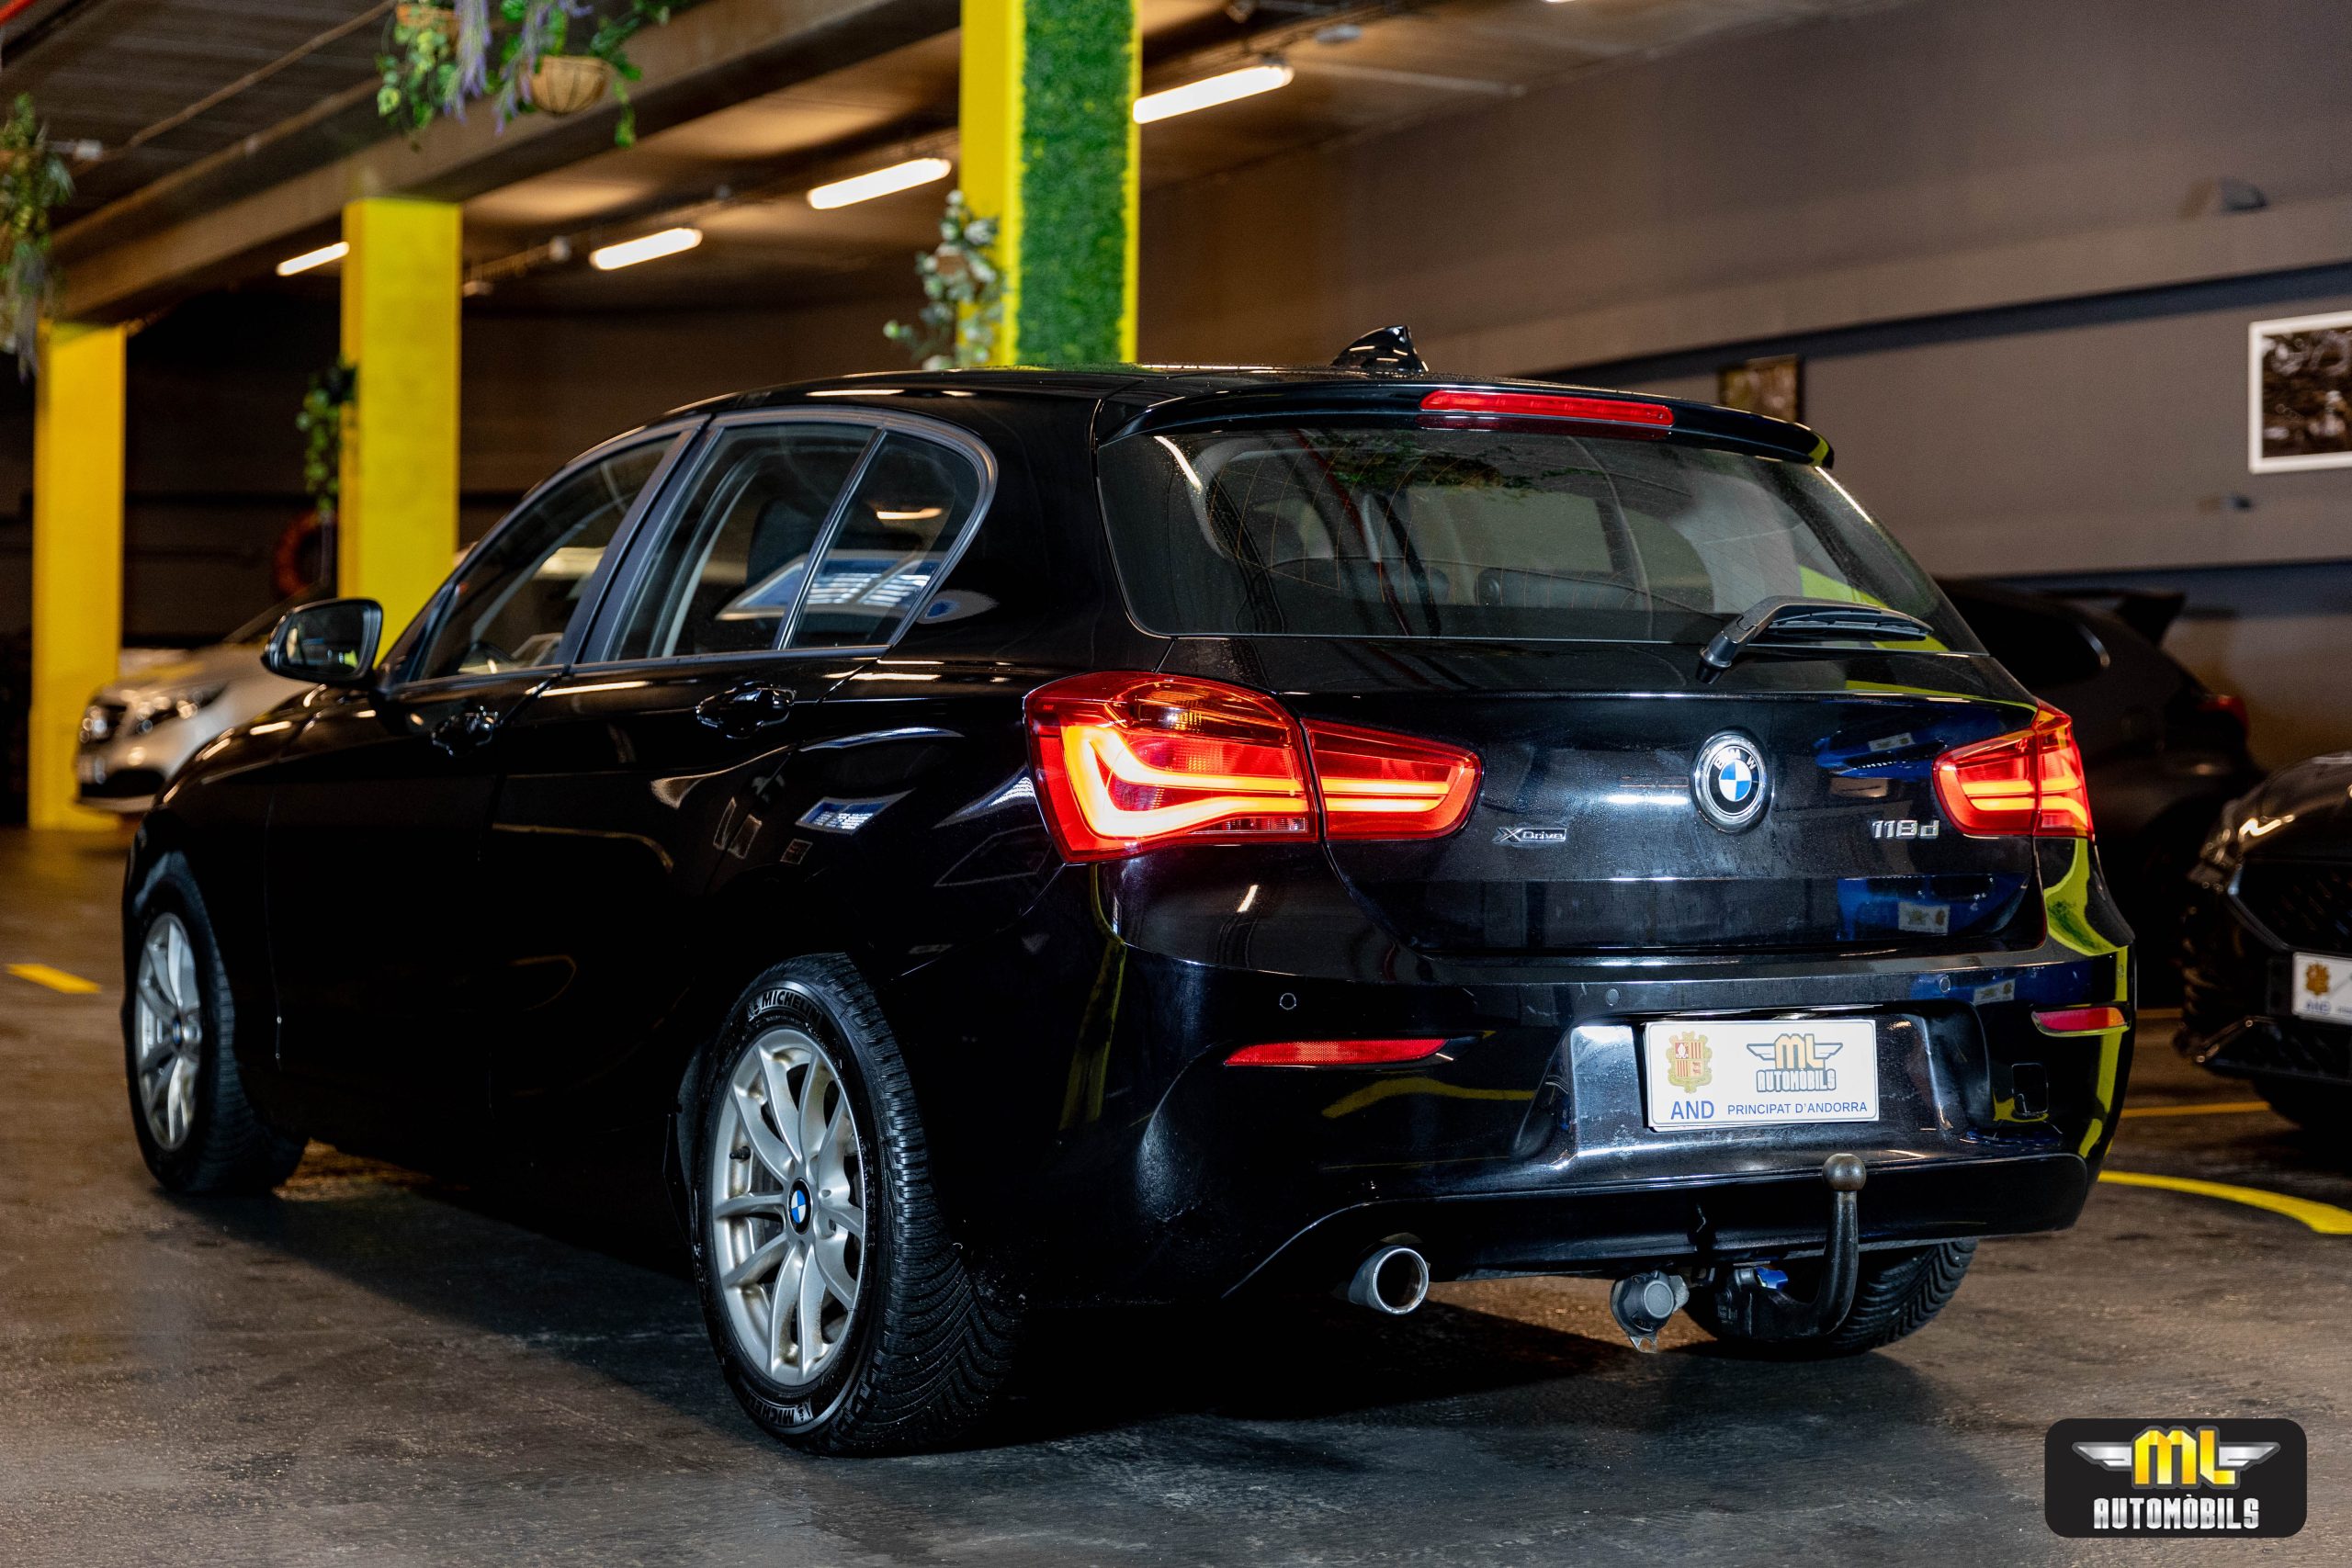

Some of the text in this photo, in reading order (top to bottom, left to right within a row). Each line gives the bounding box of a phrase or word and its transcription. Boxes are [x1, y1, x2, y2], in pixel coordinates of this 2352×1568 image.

[1713, 747, 1757, 770] BMW
[1871, 819, 1939, 839] 118d
[762, 990, 821, 1021] MICHELIN
[1774, 1033, 1826, 1069] ML
[1670, 1100, 1715, 1120] AND
[1727, 1102, 1868, 1115] PRINCIPAT D'ANDORRA
